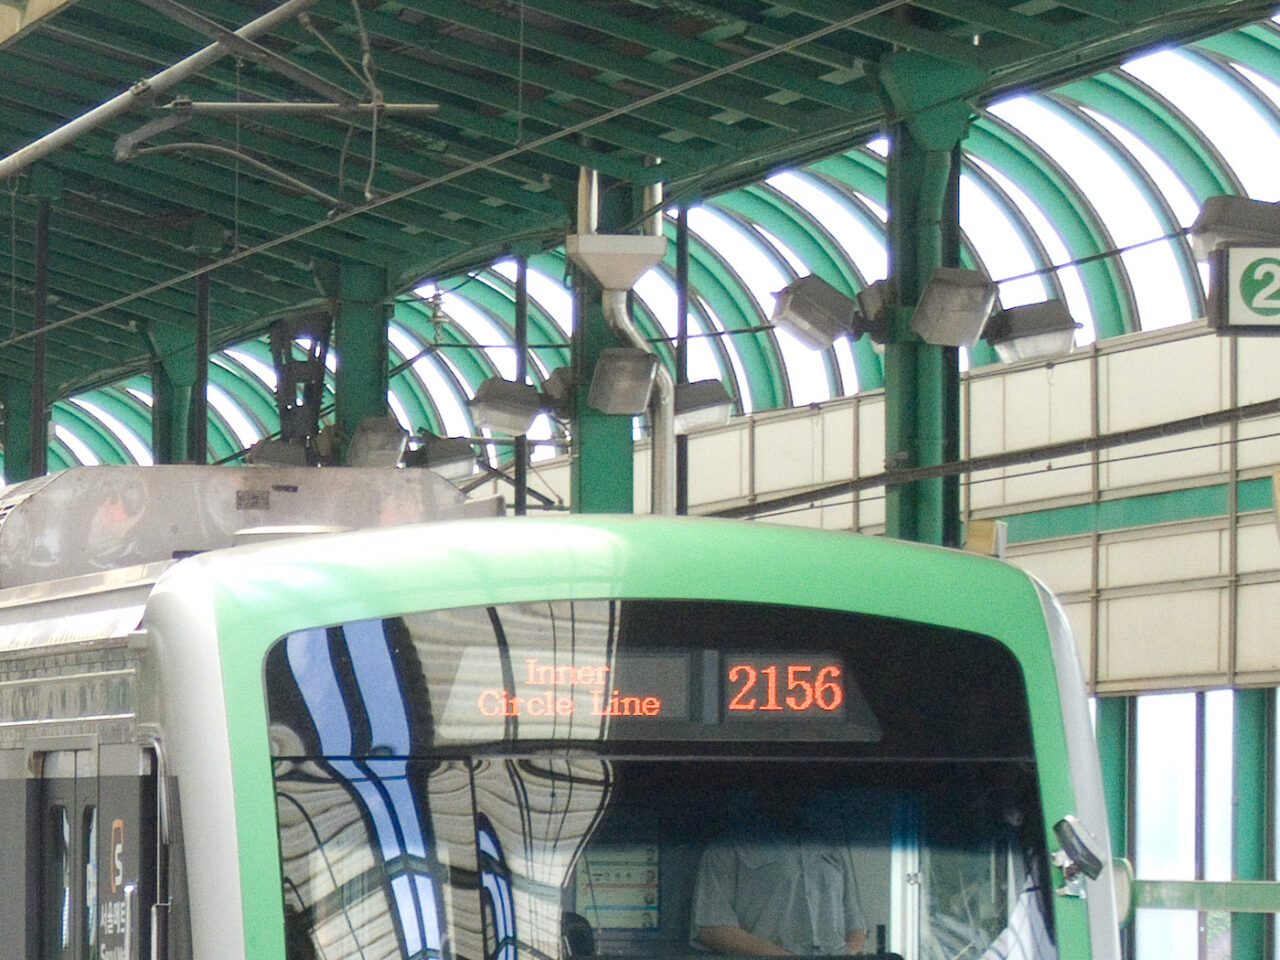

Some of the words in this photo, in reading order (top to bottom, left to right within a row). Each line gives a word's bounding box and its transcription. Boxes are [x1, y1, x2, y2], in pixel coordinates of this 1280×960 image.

[1253, 263, 1280, 309] 2
[524, 659, 609, 685] Inner
[728, 665, 843, 711] 2156
[478, 690, 575, 716] Circle
[590, 690, 661, 716] Line
[100, 901, 126, 935] 서울메트
